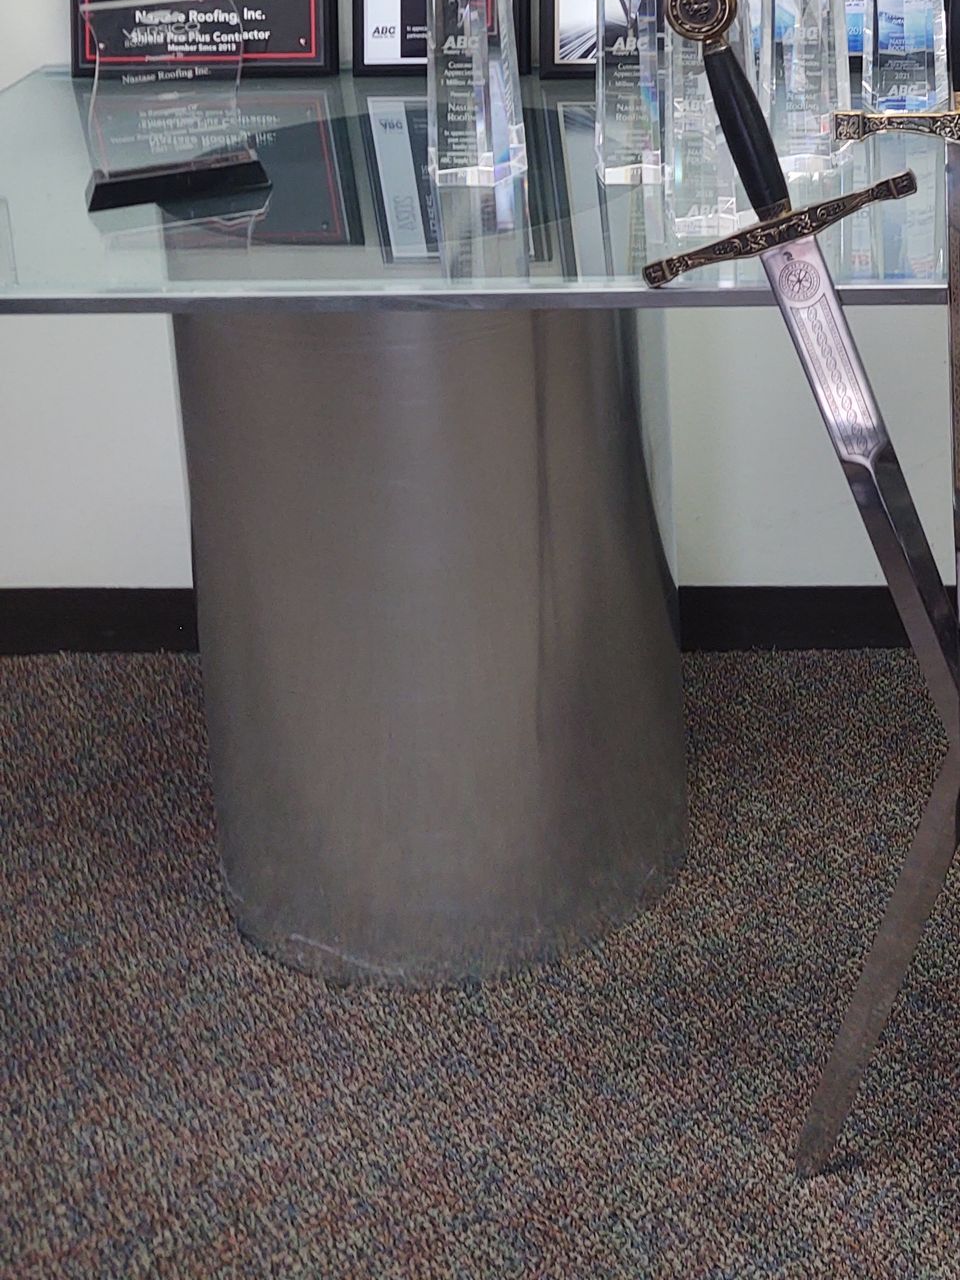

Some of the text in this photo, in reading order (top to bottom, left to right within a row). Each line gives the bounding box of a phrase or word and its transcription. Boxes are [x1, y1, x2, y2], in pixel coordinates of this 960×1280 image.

[243, 7, 266, 20] Inc.
[189, 30, 211, 43] Plus
[213, 29, 271, 43] Contractor
[372, 26, 396, 35] ABC
[167, 43, 197, 52] Member
[198, 43, 217, 52] Since
[442, 35, 481, 49] ABC
[158, 68, 193, 81] Roofing
[194, 66, 211, 76] Inc.
